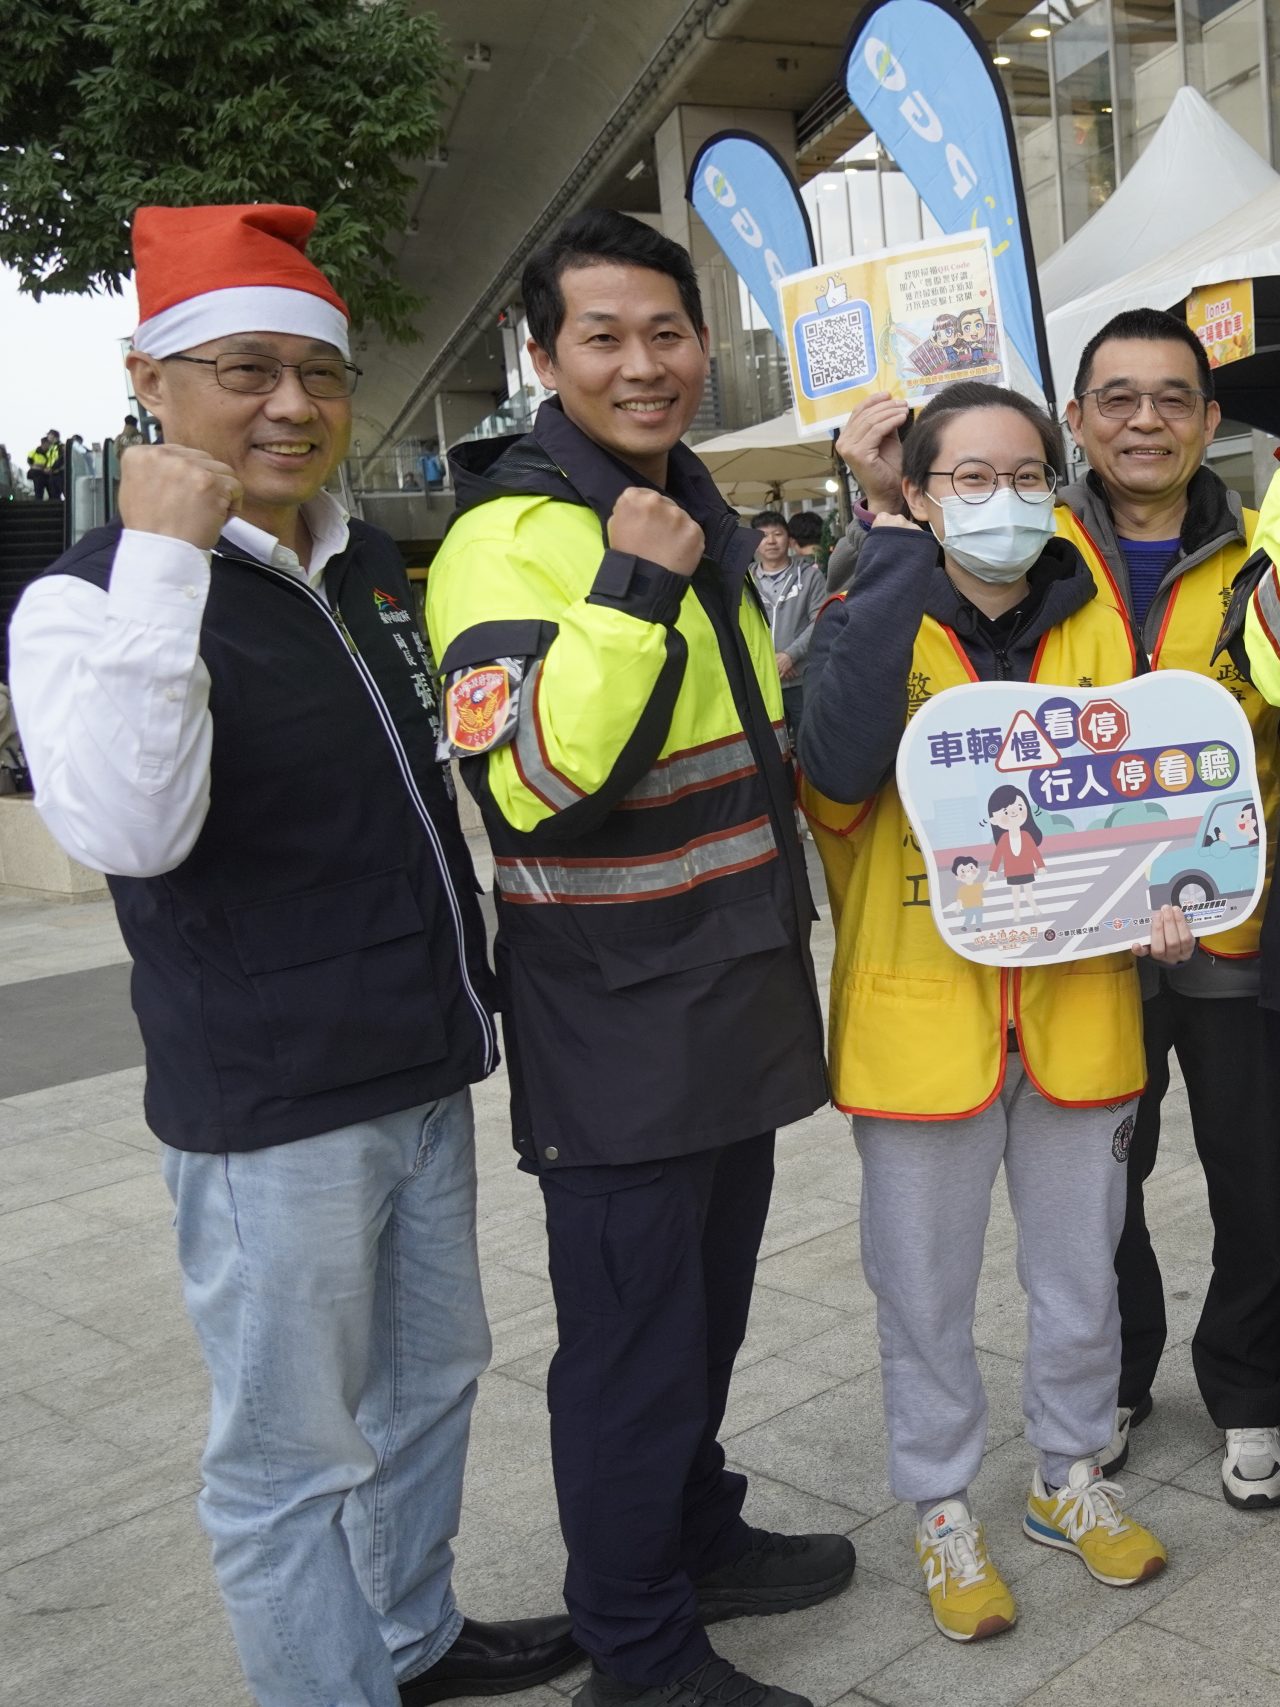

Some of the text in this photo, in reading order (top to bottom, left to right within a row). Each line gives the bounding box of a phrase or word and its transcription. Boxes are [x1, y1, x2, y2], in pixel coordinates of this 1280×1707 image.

[927, 706, 1119, 768] 車輛慢看停
[1039, 747, 1232, 803] 行人停看聽
[1133, 917, 1152, 925] 交通部
